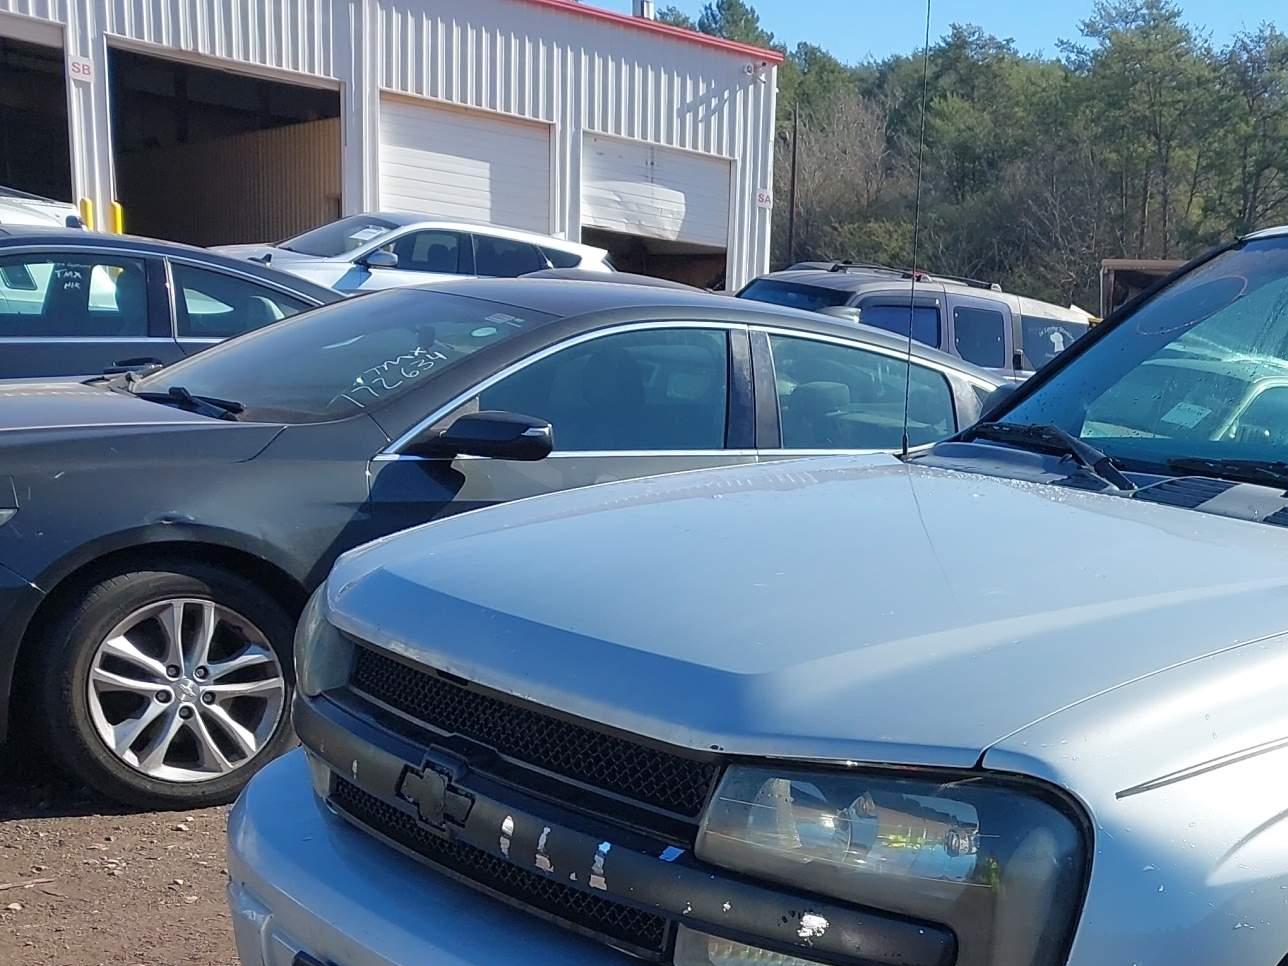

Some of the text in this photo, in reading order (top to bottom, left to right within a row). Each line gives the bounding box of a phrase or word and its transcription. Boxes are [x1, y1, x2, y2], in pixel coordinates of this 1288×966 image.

[71, 62, 91, 75] SB
[758, 193, 771, 203] SA
[55, 268, 82, 279] TMX
